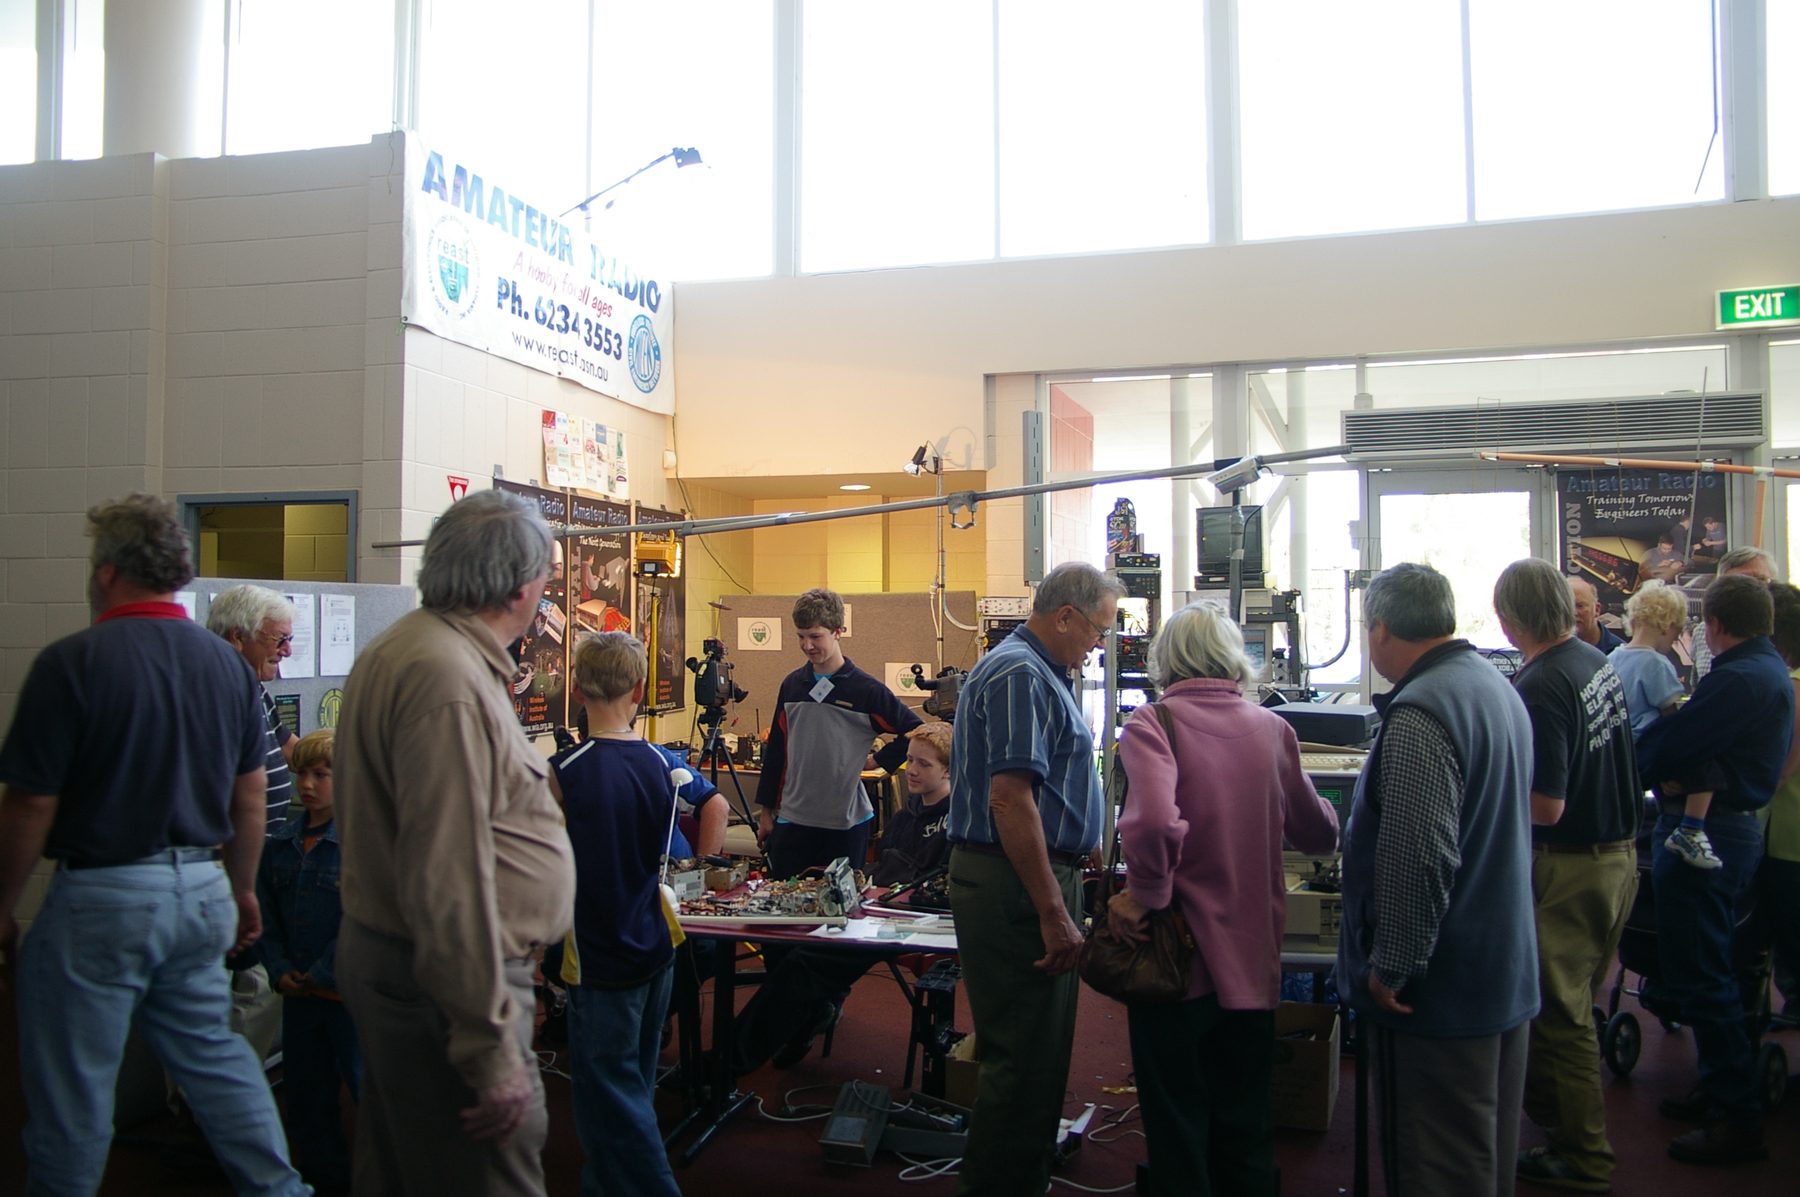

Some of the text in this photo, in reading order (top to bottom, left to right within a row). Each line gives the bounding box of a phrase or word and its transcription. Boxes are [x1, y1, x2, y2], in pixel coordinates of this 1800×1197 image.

[421, 150, 574, 266] AMATEUR
[497, 276, 530, 321] Ph.
[591, 296, 613, 318] ages
[1735, 292, 1785, 319] EXIT
[1567, 473, 1716, 492] Amateur Radio
[540, 494, 565, 516] Radio
[1586, 494, 1635, 509] Training
[572, 501, 607, 523] Amateur
[607, 507, 629, 525] Radio
[1595, 506, 1686, 523] Engineers Today
